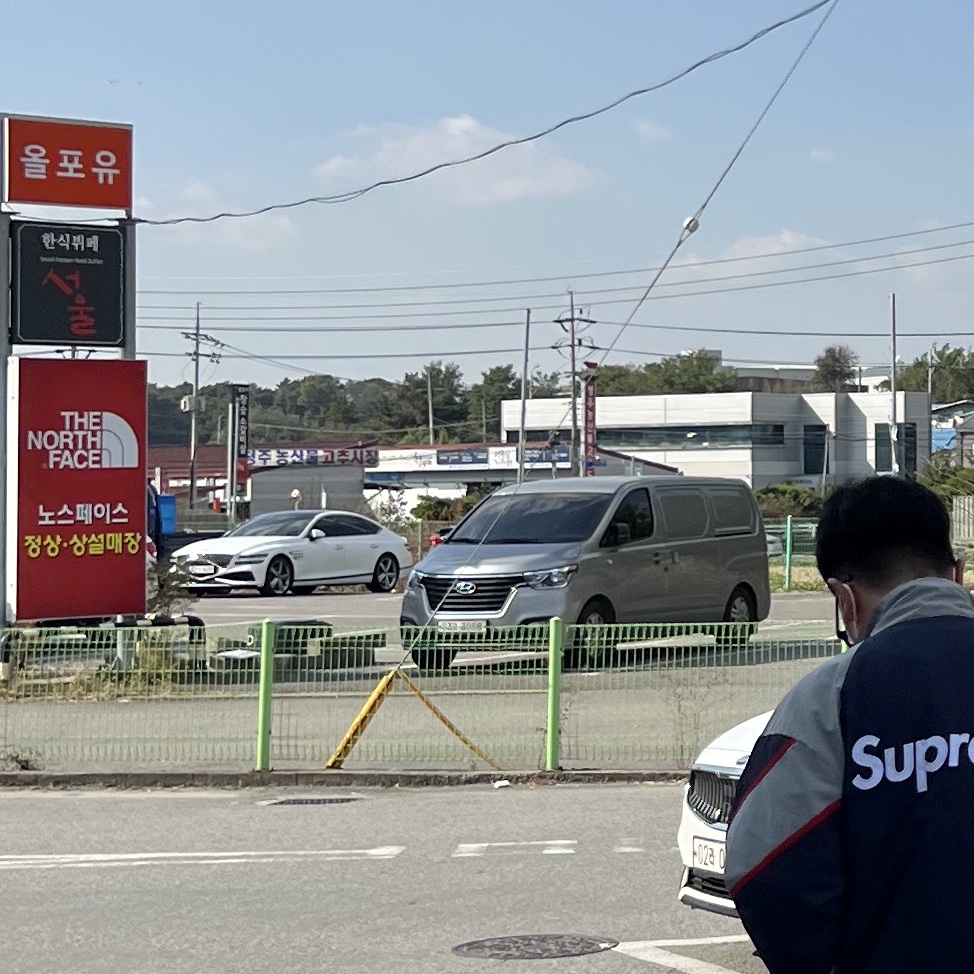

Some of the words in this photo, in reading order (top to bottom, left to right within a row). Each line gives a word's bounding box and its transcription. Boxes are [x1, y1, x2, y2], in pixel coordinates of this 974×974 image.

[20, 144, 120, 185] 올포유
[41, 231, 99, 253] 한식뷔페
[60, 411, 101, 430] THE
[27, 430, 101, 450] NORTH
[48, 449, 101, 469] FACE
[38, 503, 129, 525] 노스페이스
